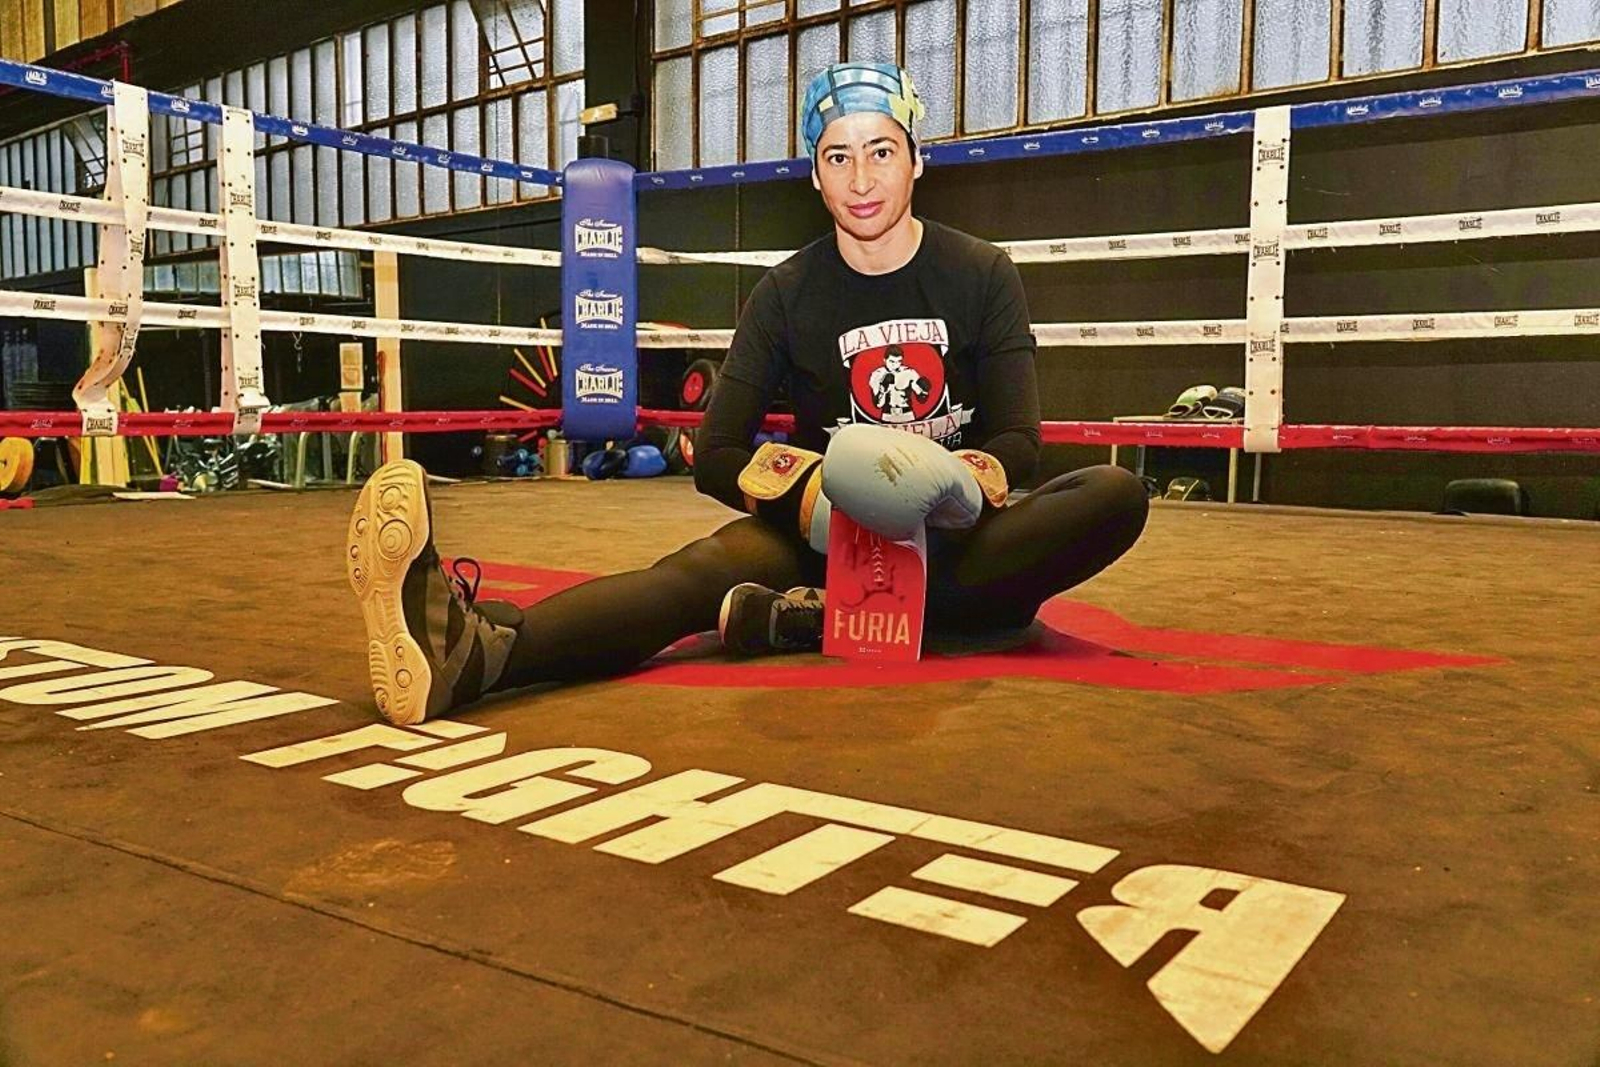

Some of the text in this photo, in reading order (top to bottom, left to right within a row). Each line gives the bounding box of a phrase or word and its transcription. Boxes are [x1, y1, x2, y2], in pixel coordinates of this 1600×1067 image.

[575, 223, 622, 254] CHARLIE
[575, 294, 622, 325] CHARLIE
[842, 320, 945, 355] LA VIEJA
[576, 368, 623, 399] CHARLIE
[87, 417, 113, 431] CHARLIE
[833, 608, 910, 645] FURIA
[238, 719, 1346, 1054] FIGHTER
